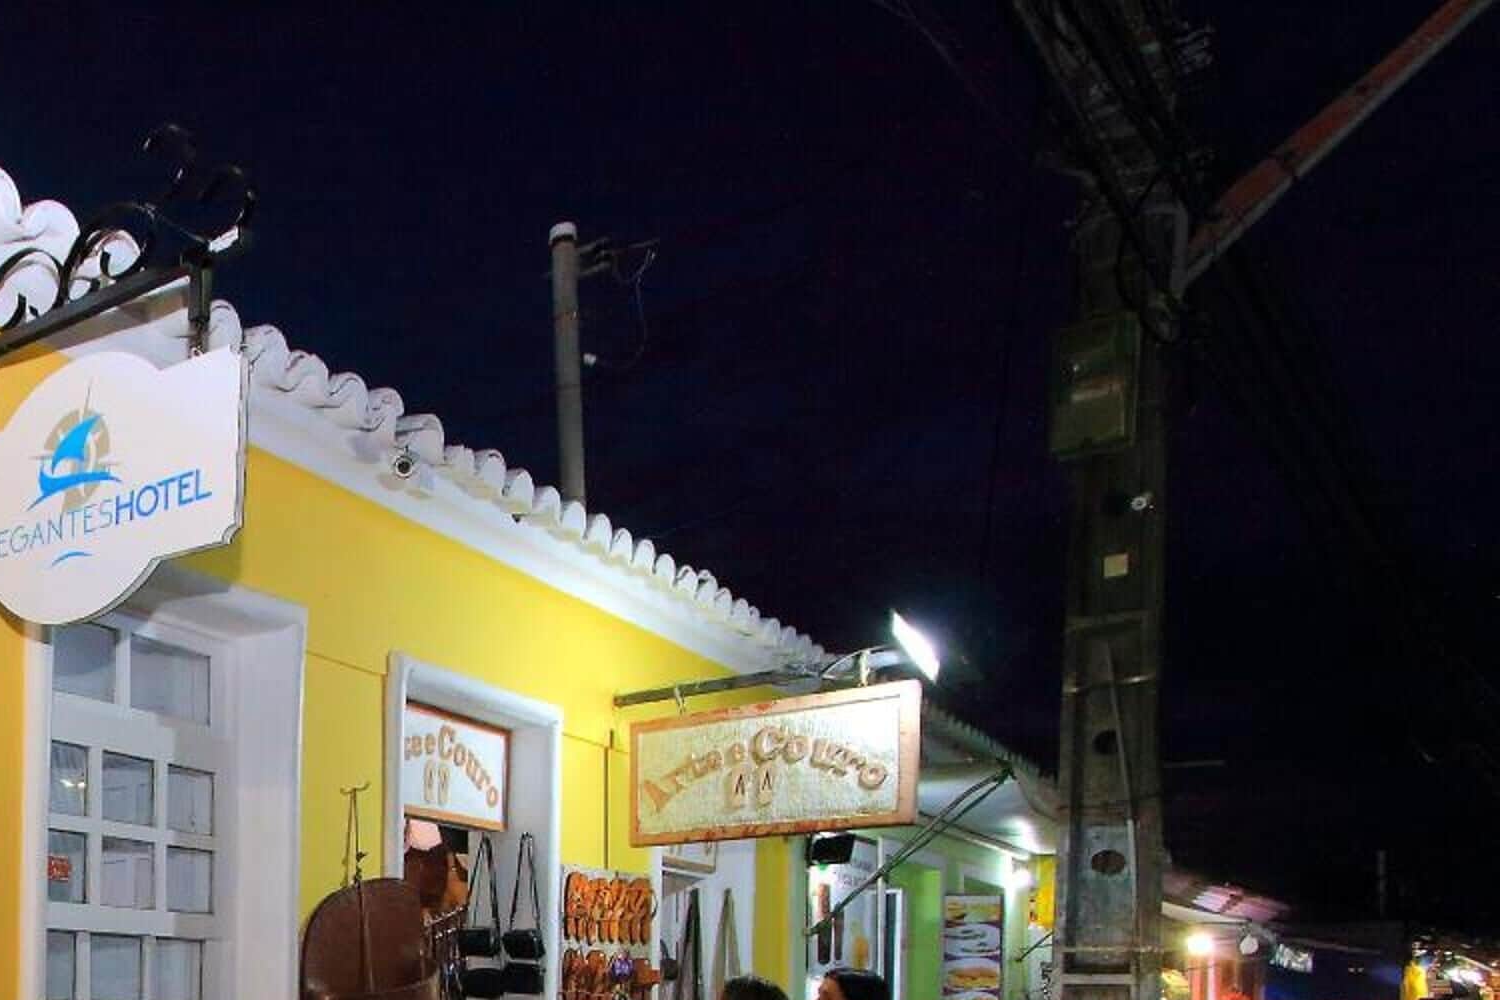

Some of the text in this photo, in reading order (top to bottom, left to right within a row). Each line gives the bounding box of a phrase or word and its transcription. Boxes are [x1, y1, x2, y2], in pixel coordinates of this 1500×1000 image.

[439, 725, 499, 807] Couro
[643, 749, 722, 814] Arte
[750, 725, 888, 790] Couro
